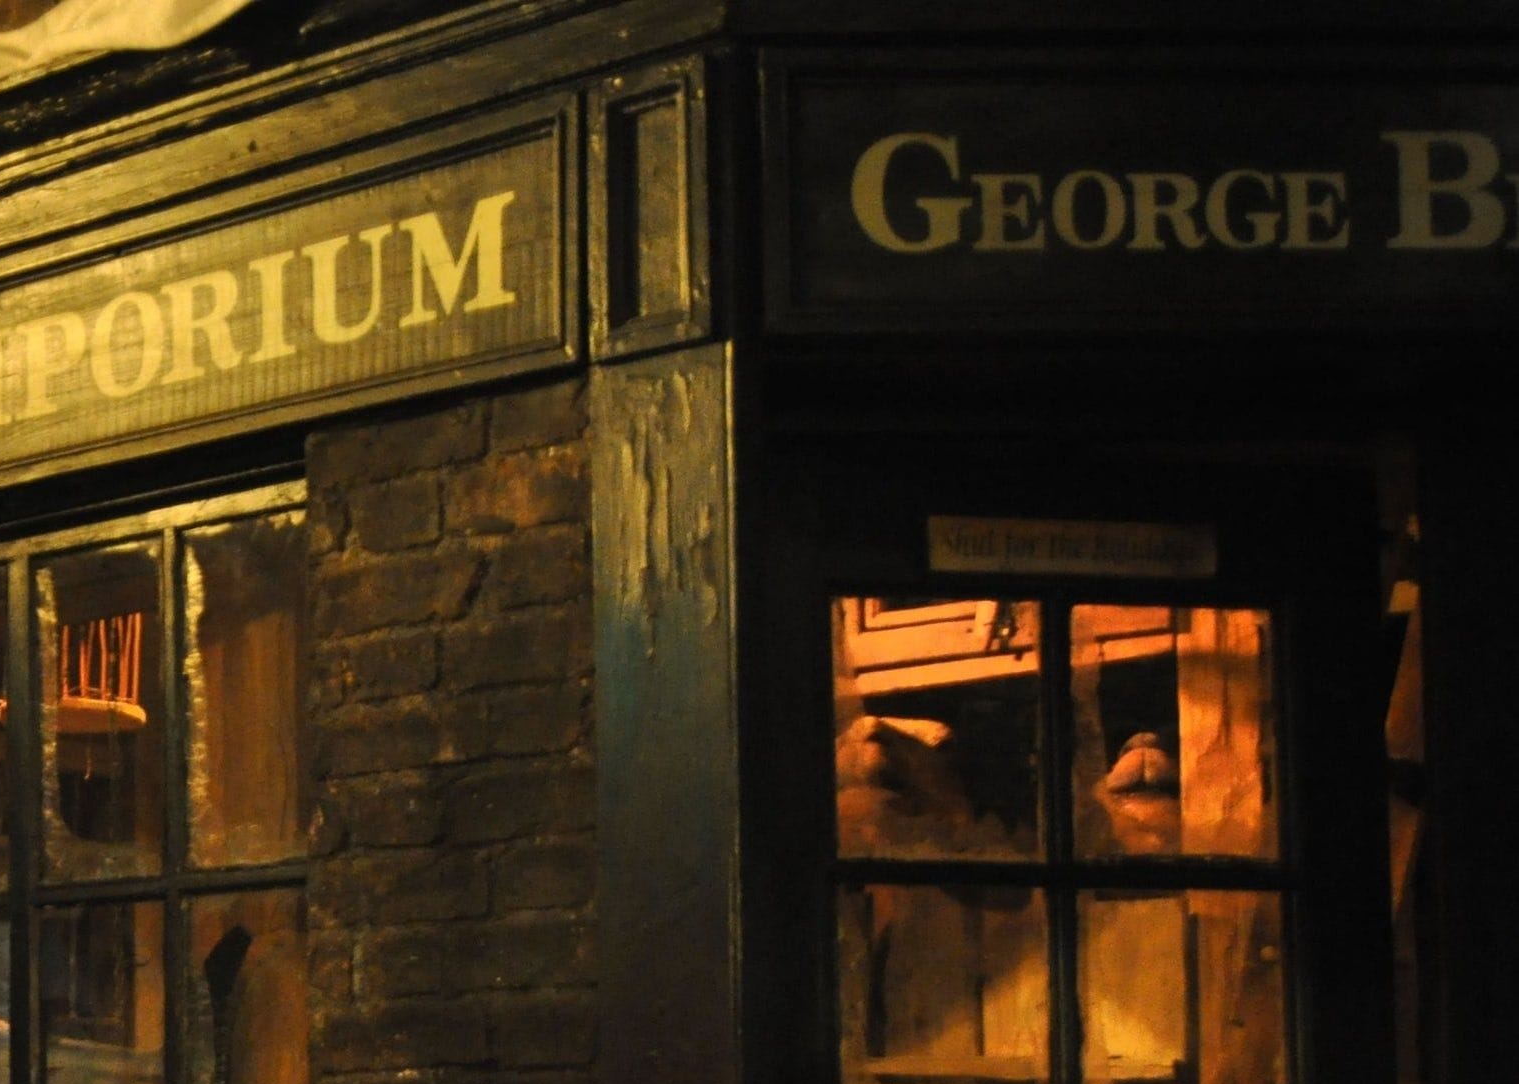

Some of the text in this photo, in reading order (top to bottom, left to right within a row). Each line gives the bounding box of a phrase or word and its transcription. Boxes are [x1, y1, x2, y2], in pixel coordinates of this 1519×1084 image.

[850, 129, 1519, 254] GEORGE B
[1003, 529, 1037, 560] for
